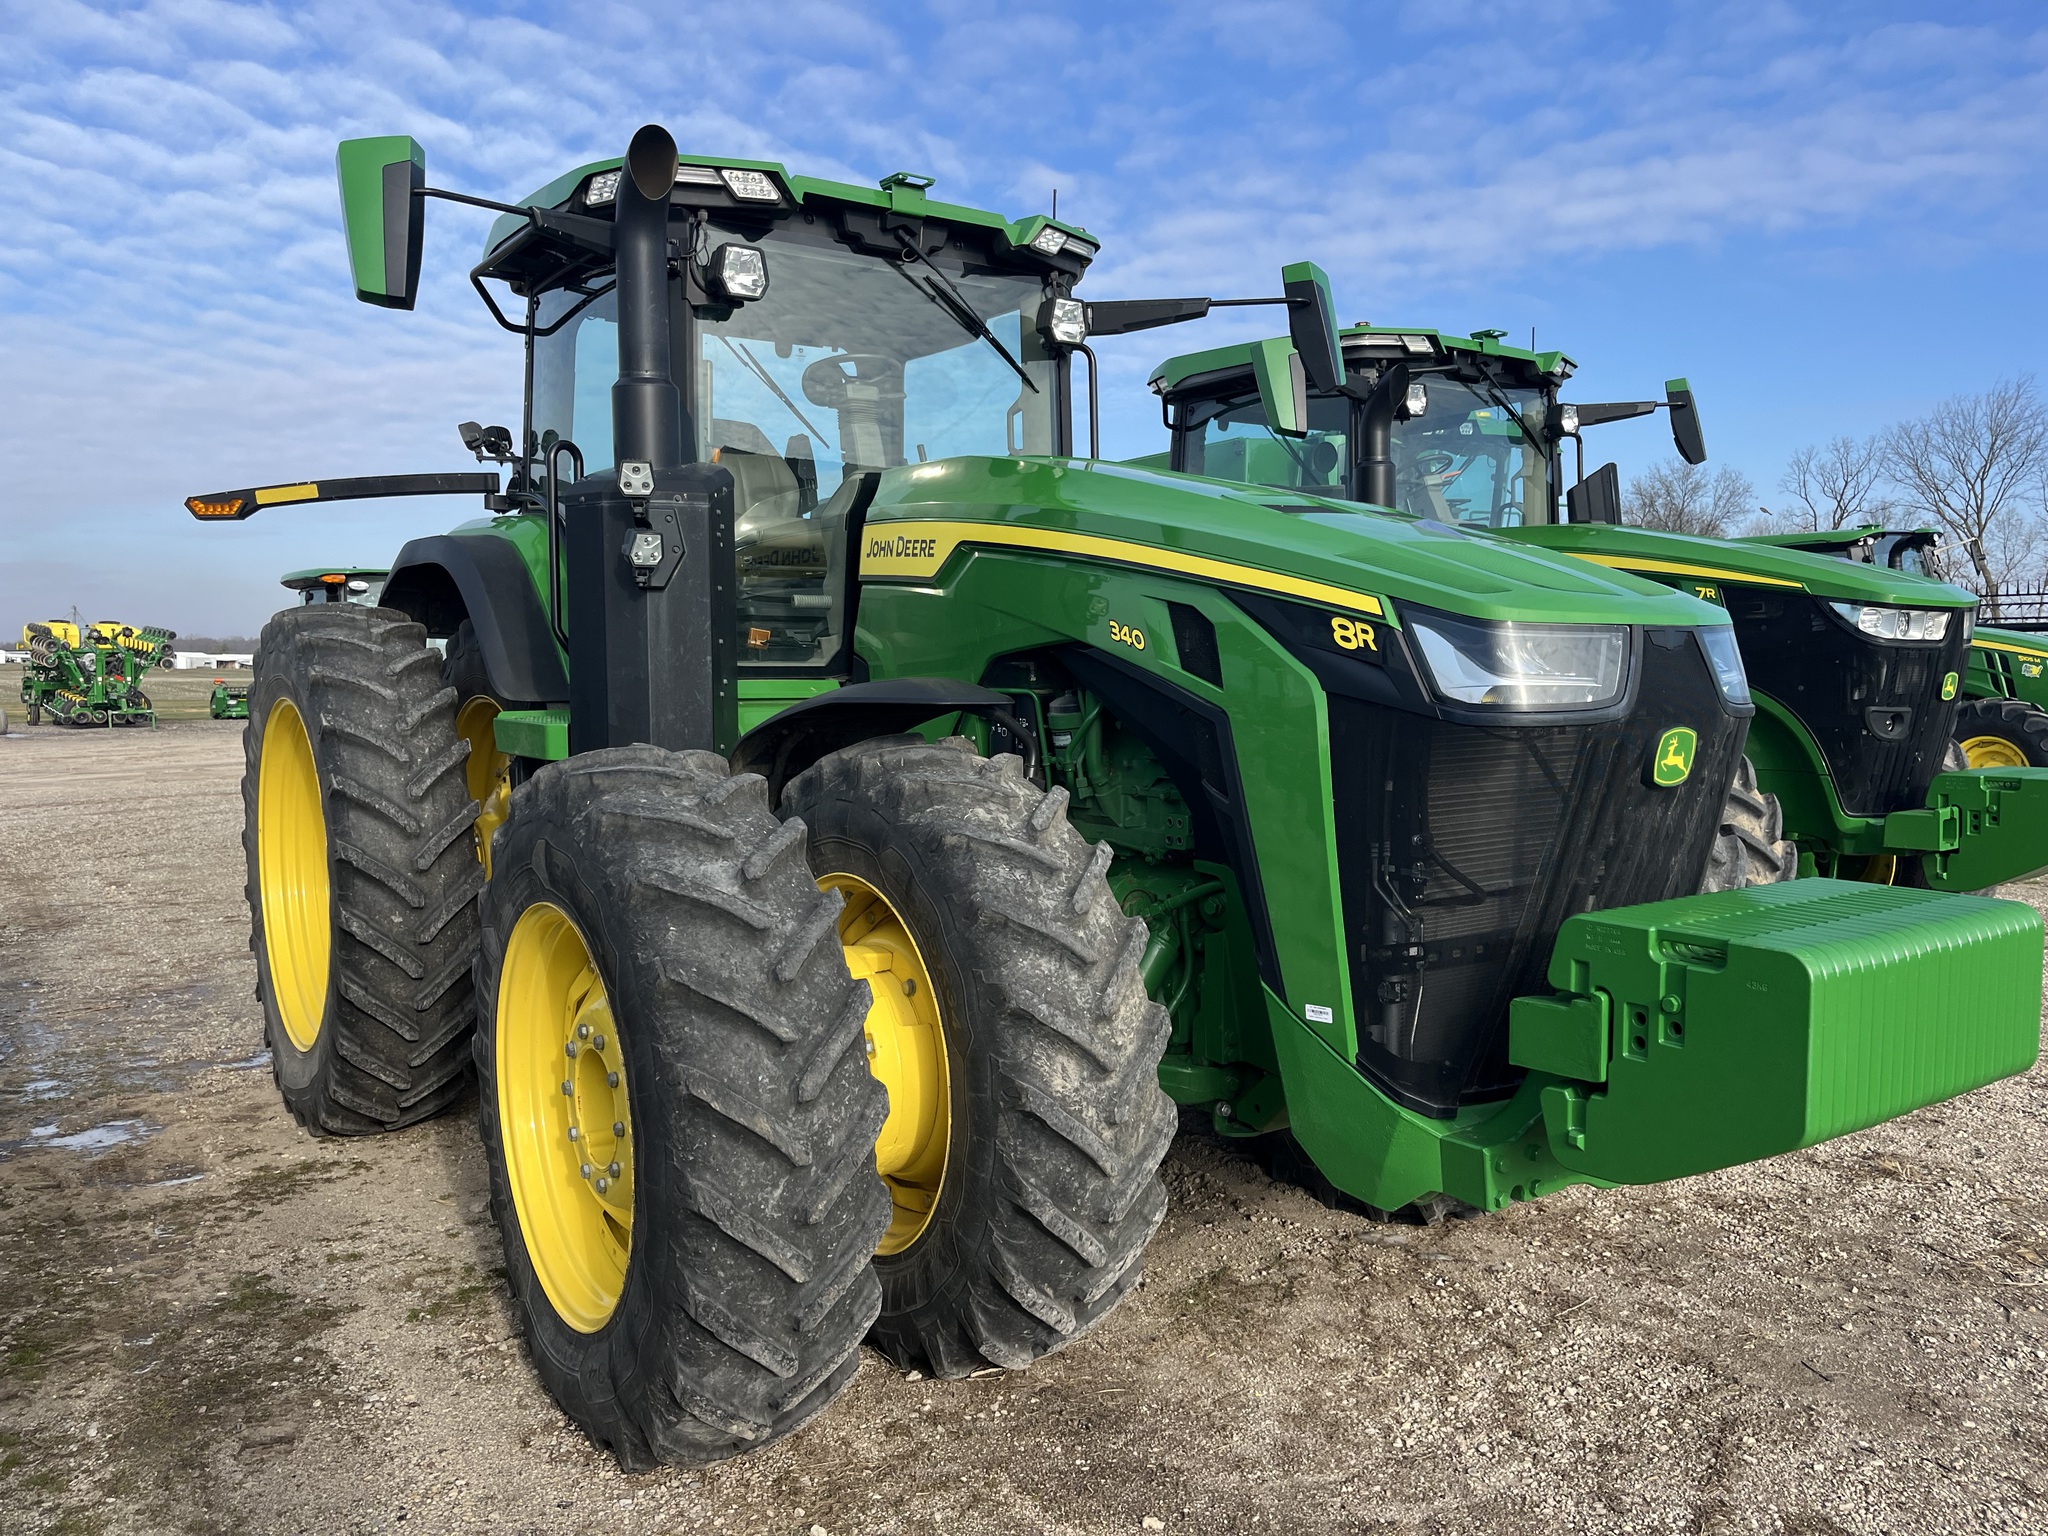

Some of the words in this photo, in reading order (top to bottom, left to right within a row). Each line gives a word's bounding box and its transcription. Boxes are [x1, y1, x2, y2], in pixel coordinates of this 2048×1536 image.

[866, 537, 893, 558] JOHN
[895, 535, 936, 558] DEERE
[1695, 586, 1716, 600] 7R
[1108, 620, 1145, 651] 340
[1331, 617, 1378, 651] 8R
